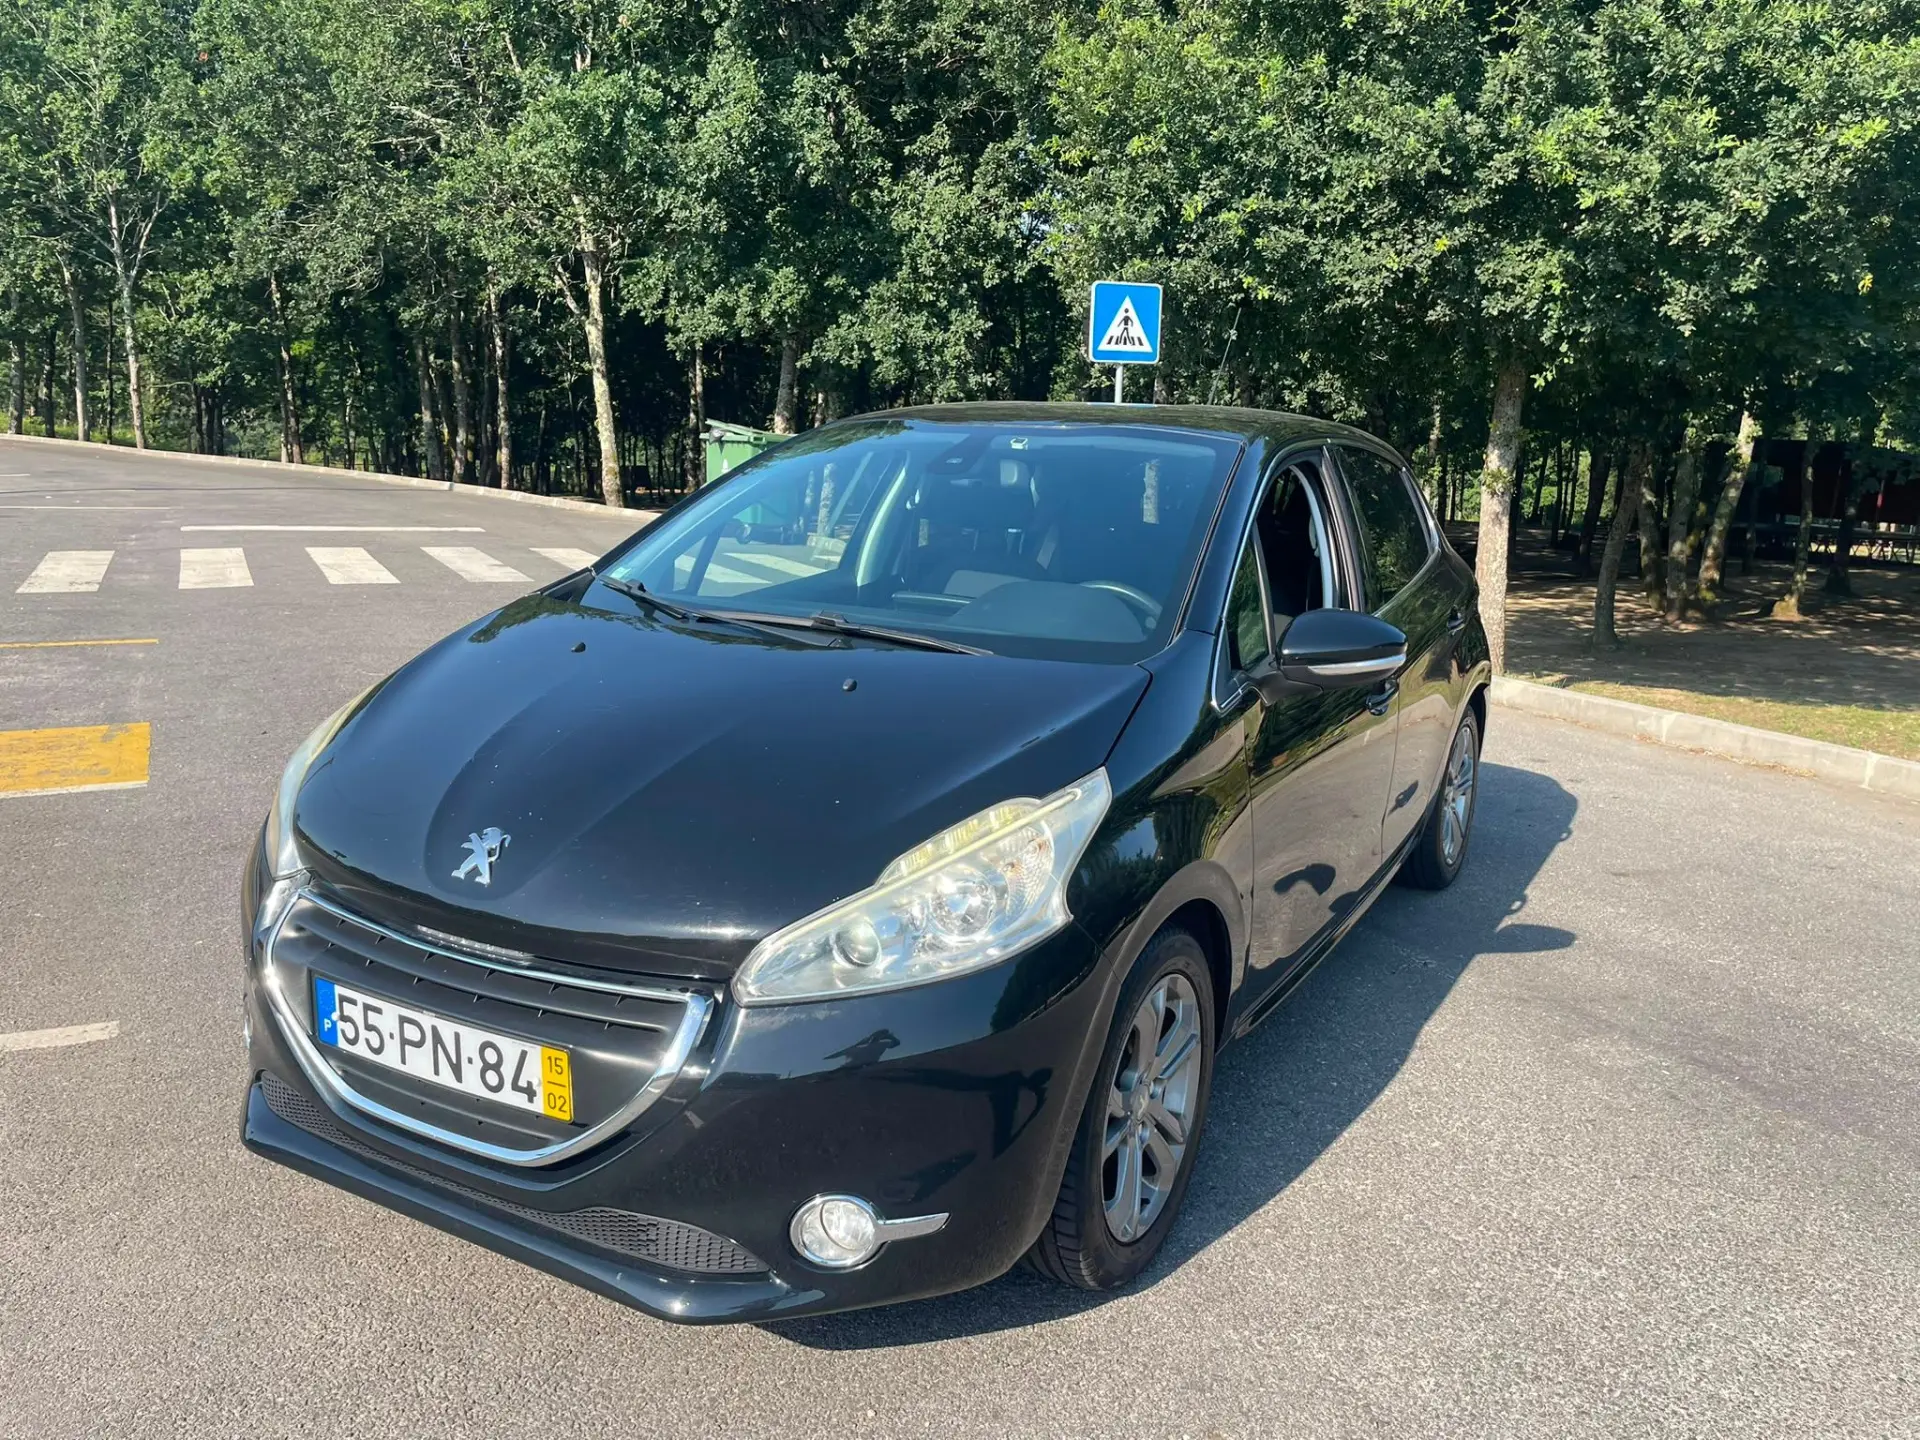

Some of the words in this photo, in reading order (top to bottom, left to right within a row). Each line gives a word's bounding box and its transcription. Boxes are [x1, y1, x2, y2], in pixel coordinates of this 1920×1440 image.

[324, 1018, 332, 1032] P
[547, 1055, 564, 1076] 15
[547, 1092, 568, 1114] 02
